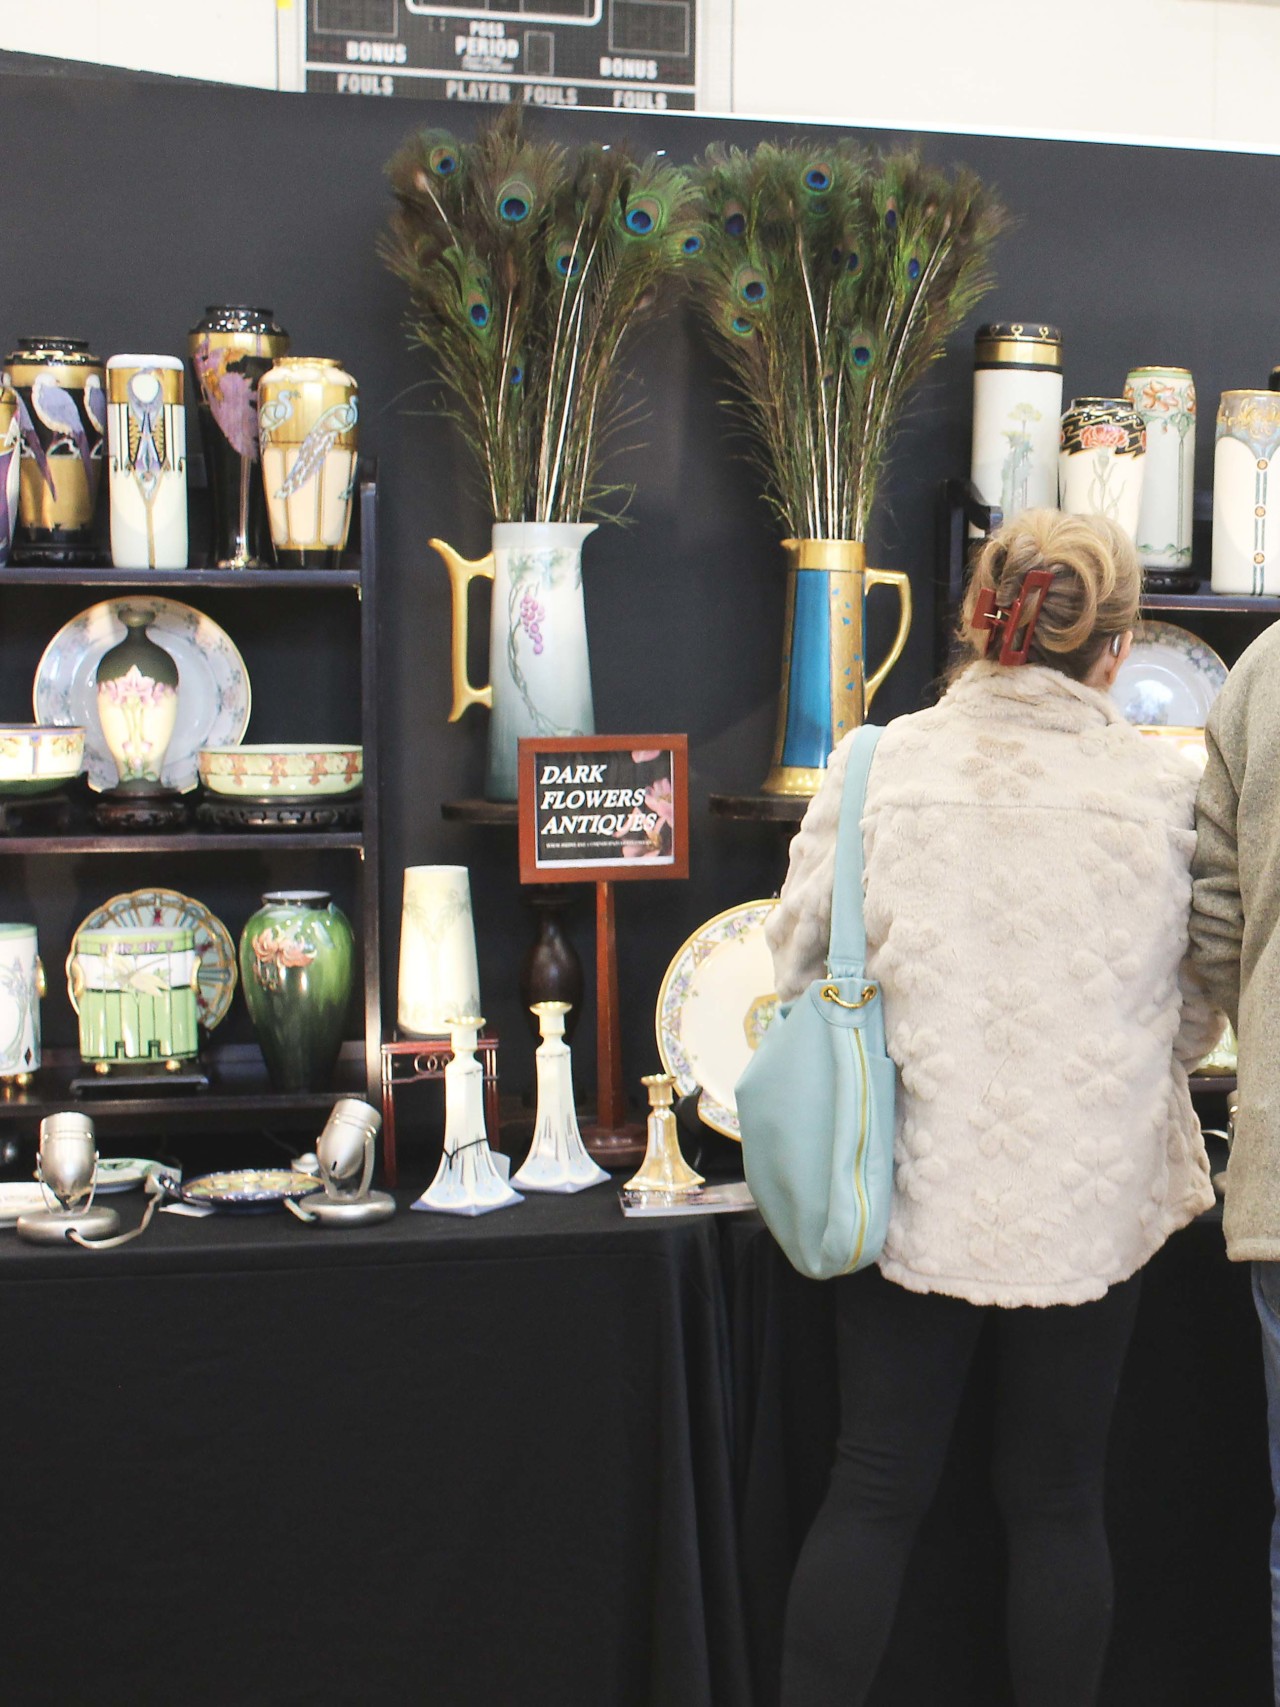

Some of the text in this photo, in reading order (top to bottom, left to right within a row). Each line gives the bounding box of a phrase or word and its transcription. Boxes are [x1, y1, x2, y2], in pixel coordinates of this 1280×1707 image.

[346, 40, 407, 64] BONUS
[454, 36, 520, 59] PERIOD
[599, 56, 658, 80] BONUS
[337, 73, 394, 97] FOULS
[445, 79, 578, 105] PLAYER FOULS
[612, 89, 668, 110] FOULS
[539, 764, 608, 785] DARK
[540, 788, 647, 810] FLOWERS
[540, 812, 659, 835] ANTIQUES
